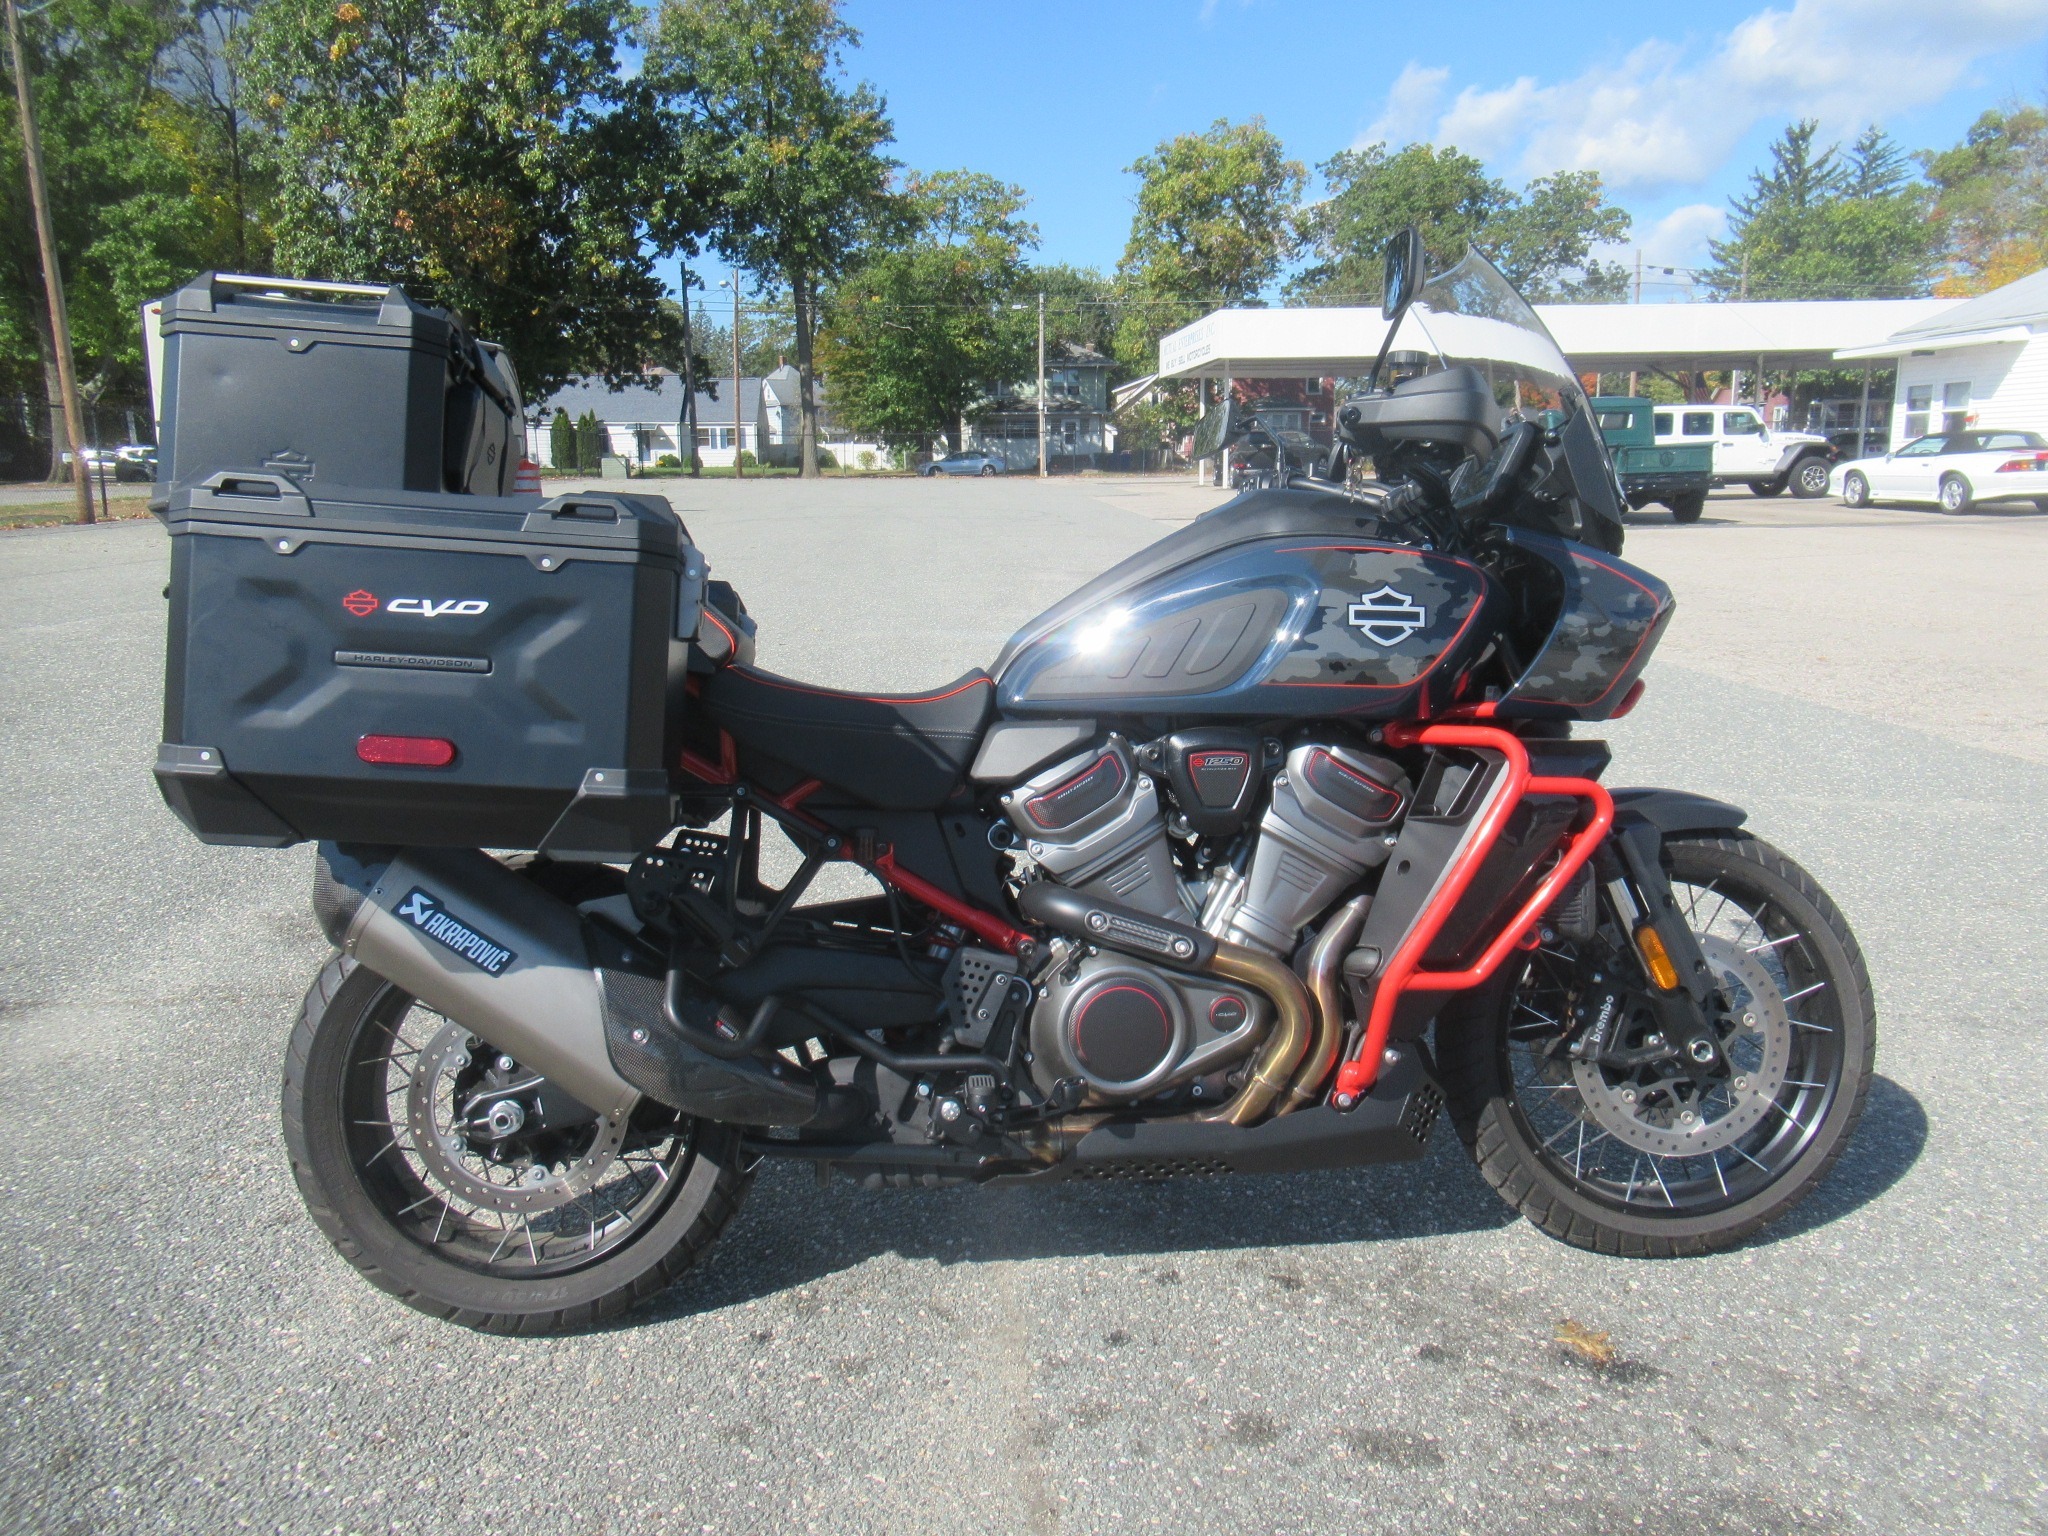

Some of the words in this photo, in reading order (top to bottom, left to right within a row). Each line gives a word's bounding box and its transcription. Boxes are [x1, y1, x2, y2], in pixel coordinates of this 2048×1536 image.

[387, 599, 489, 617] CVO
[354, 654, 474, 668] HARLEY-DAVIDSON
[1205, 757, 1244, 766] 1250
[1590, 995, 1614, 1042] brembo
